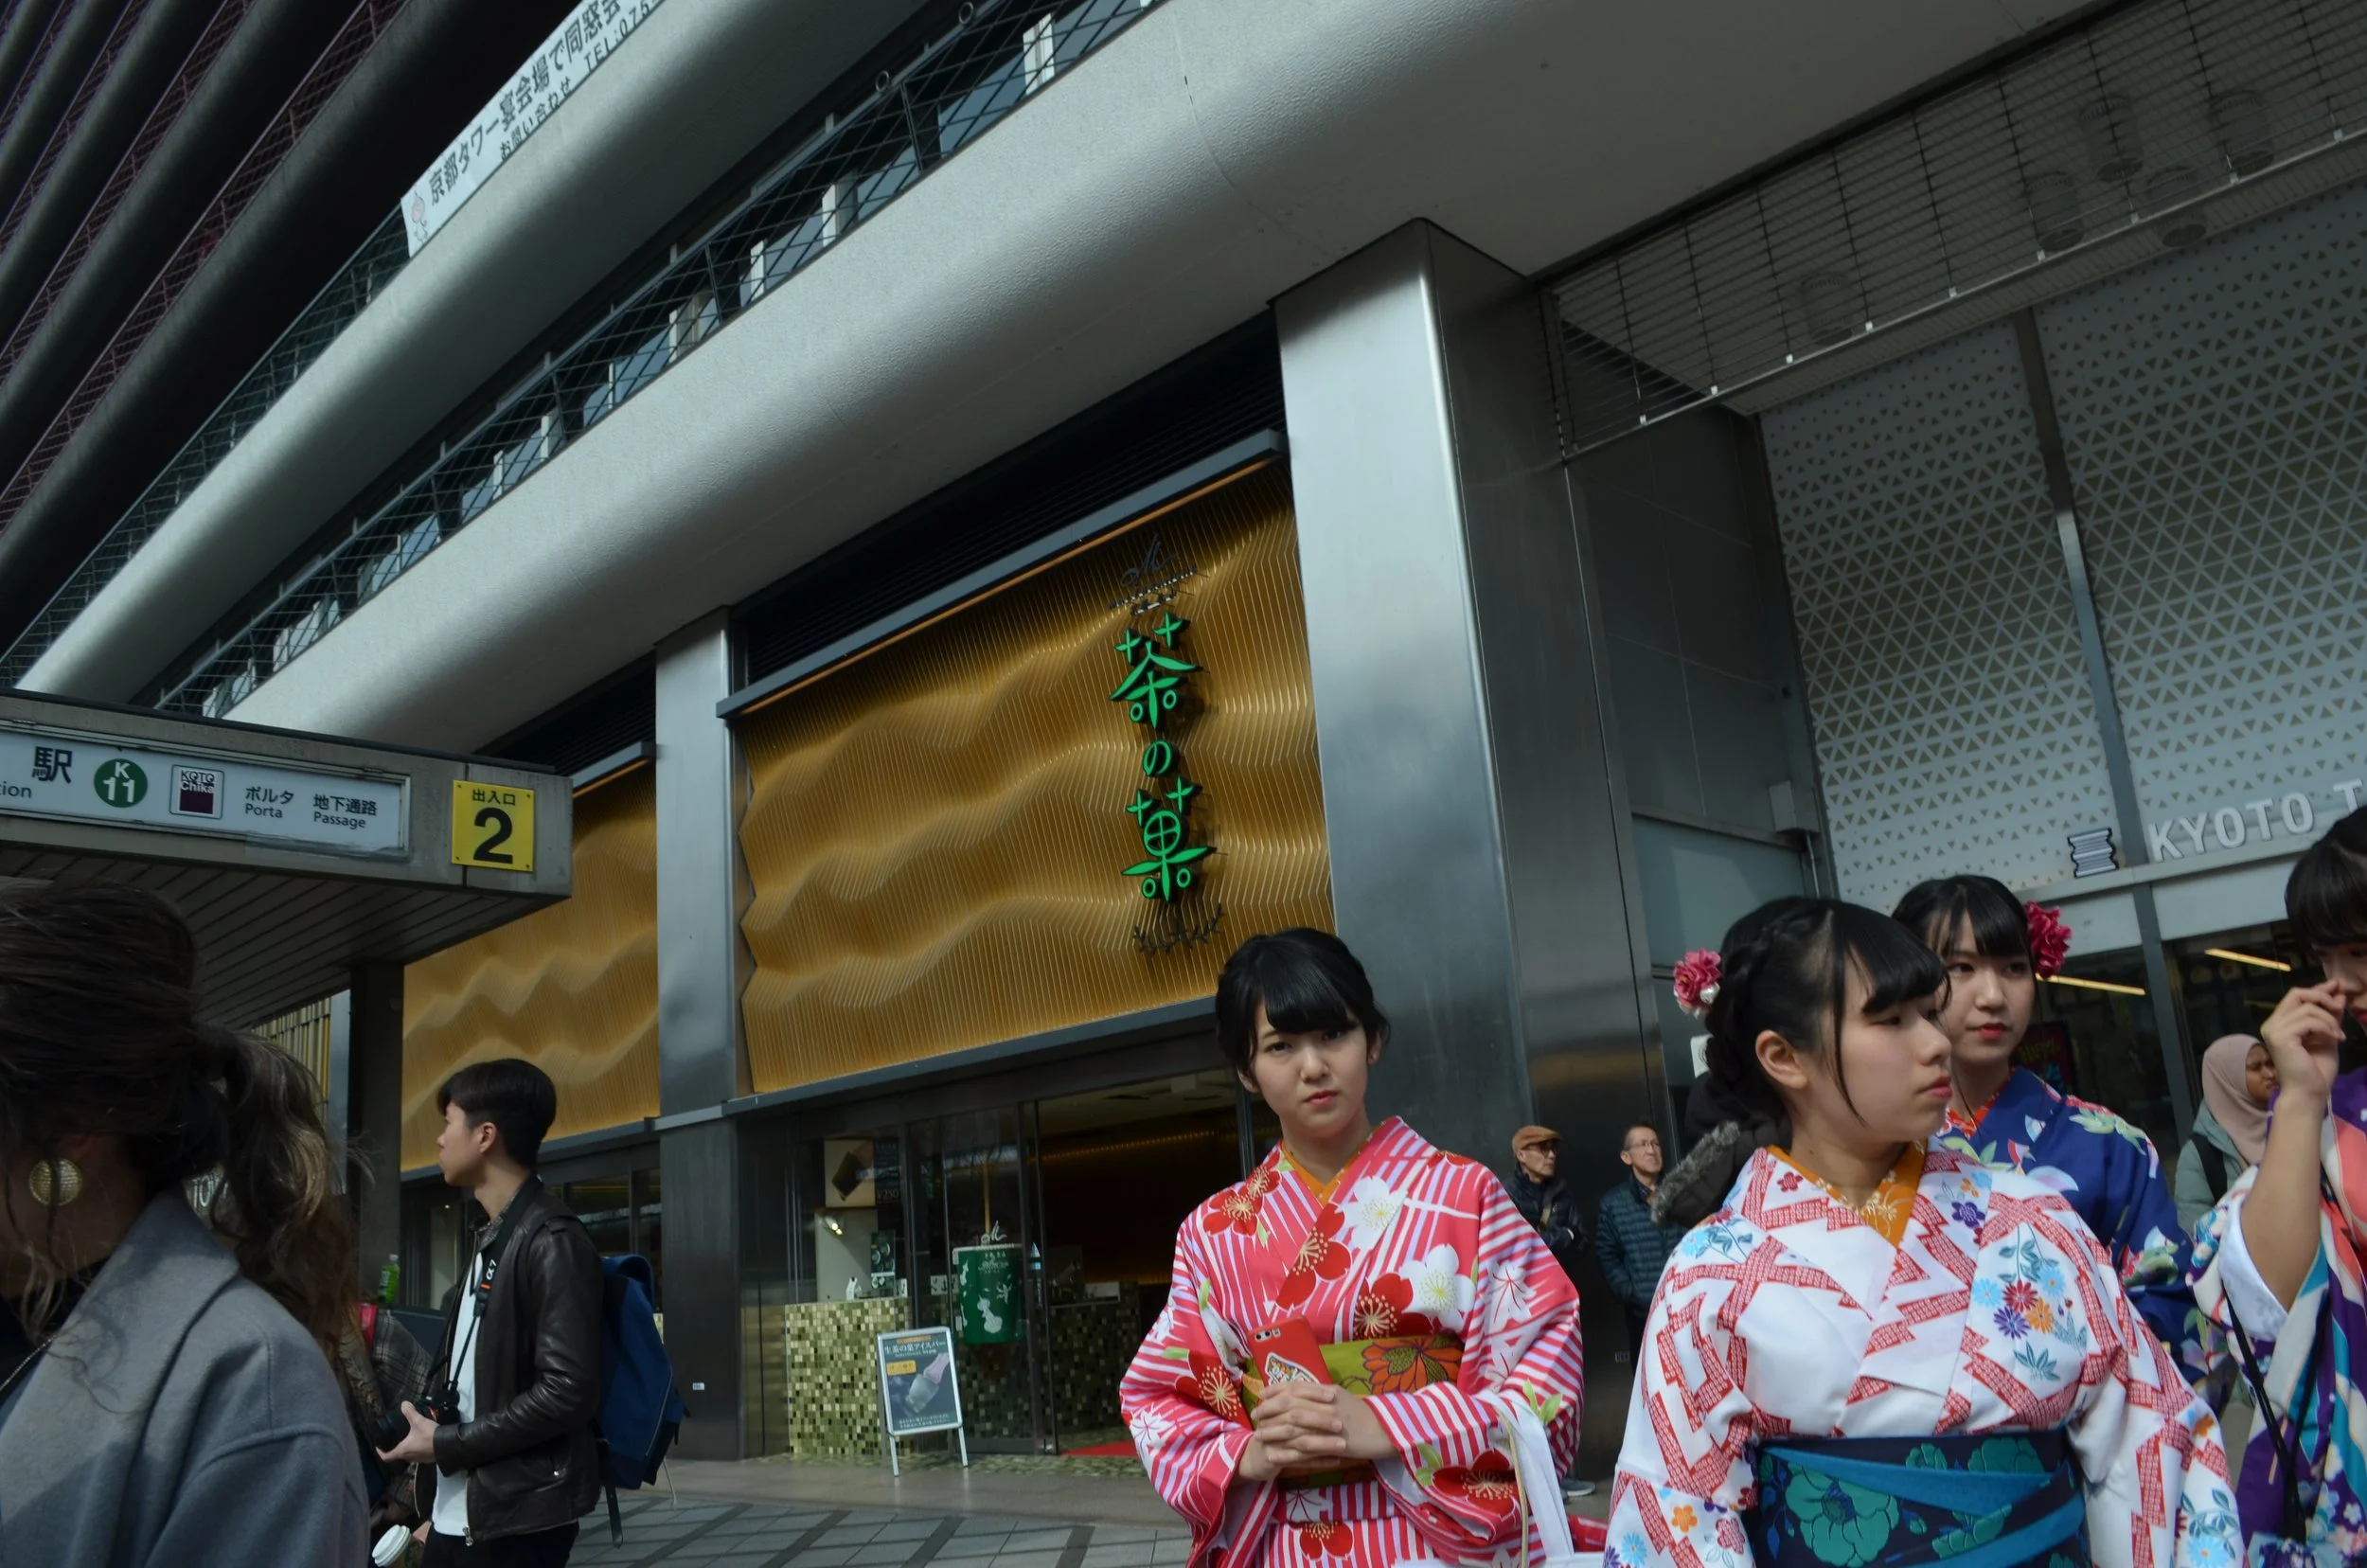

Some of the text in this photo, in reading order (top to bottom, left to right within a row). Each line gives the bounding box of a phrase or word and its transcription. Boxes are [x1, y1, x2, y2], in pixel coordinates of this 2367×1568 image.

[31, 746, 73, 784] 駅
[115, 761, 131, 779] K
[1110, 611, 1212, 902] 茶の菓
[102, 776, 135, 803] 11
[180, 780, 215, 793] Chika
[472, 789, 516, 806] 出入口
[245, 786, 377, 816] ポルタ 地下通路
[245, 803, 366, 829] Porta Passage
[2148, 791, 2315, 863] KYOTO
[473, 807, 513, 864] 2
